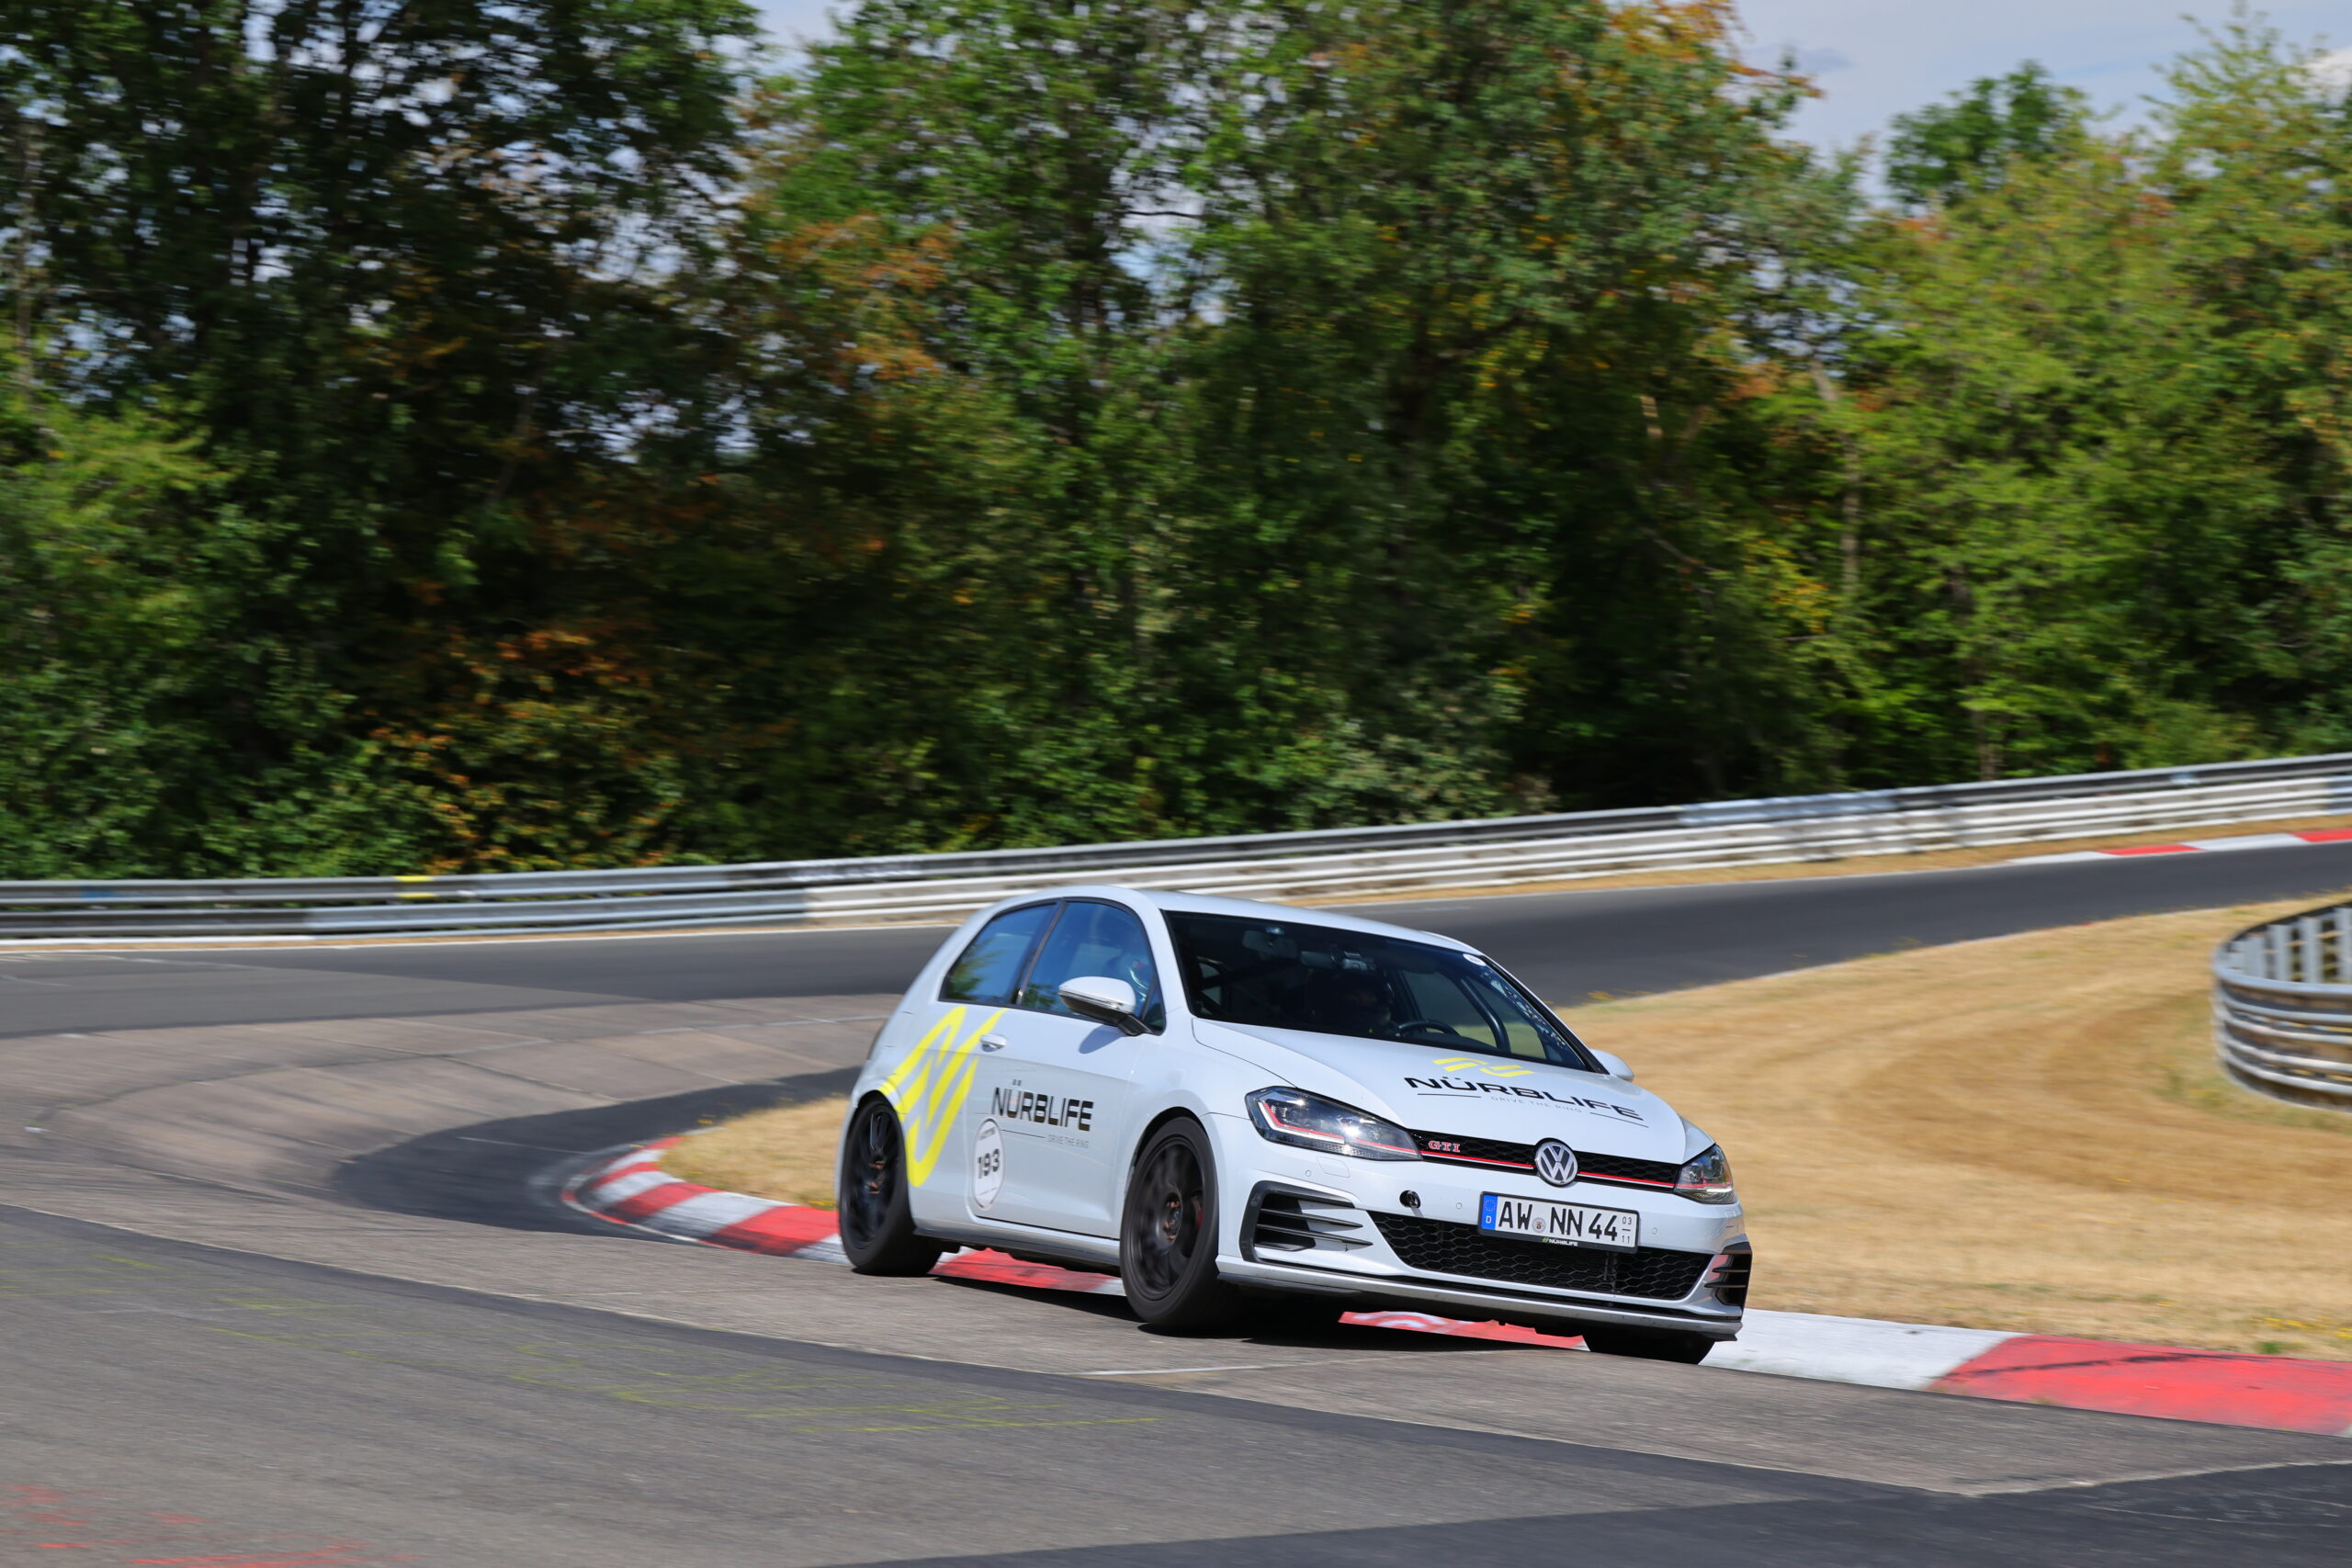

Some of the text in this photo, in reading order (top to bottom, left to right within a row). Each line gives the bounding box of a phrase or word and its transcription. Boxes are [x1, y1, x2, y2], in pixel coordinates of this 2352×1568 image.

[991, 1079, 1094, 1132] NÜRBLIFE
[1404, 1076, 1645, 1122] NÜRBLIFE
[1491, 1096, 1525, 1104] DRIVE
[1555, 1104, 1582, 1113] RING
[1428, 1140, 1461, 1153] GTI
[978, 1148, 1000, 1179] 193
[1486, 1215, 1492, 1224] D
[1498, 1201, 1617, 1241] AW NN 44
[1622, 1215, 1633, 1225] 03
[1621, 1235, 1631, 1244] 11
